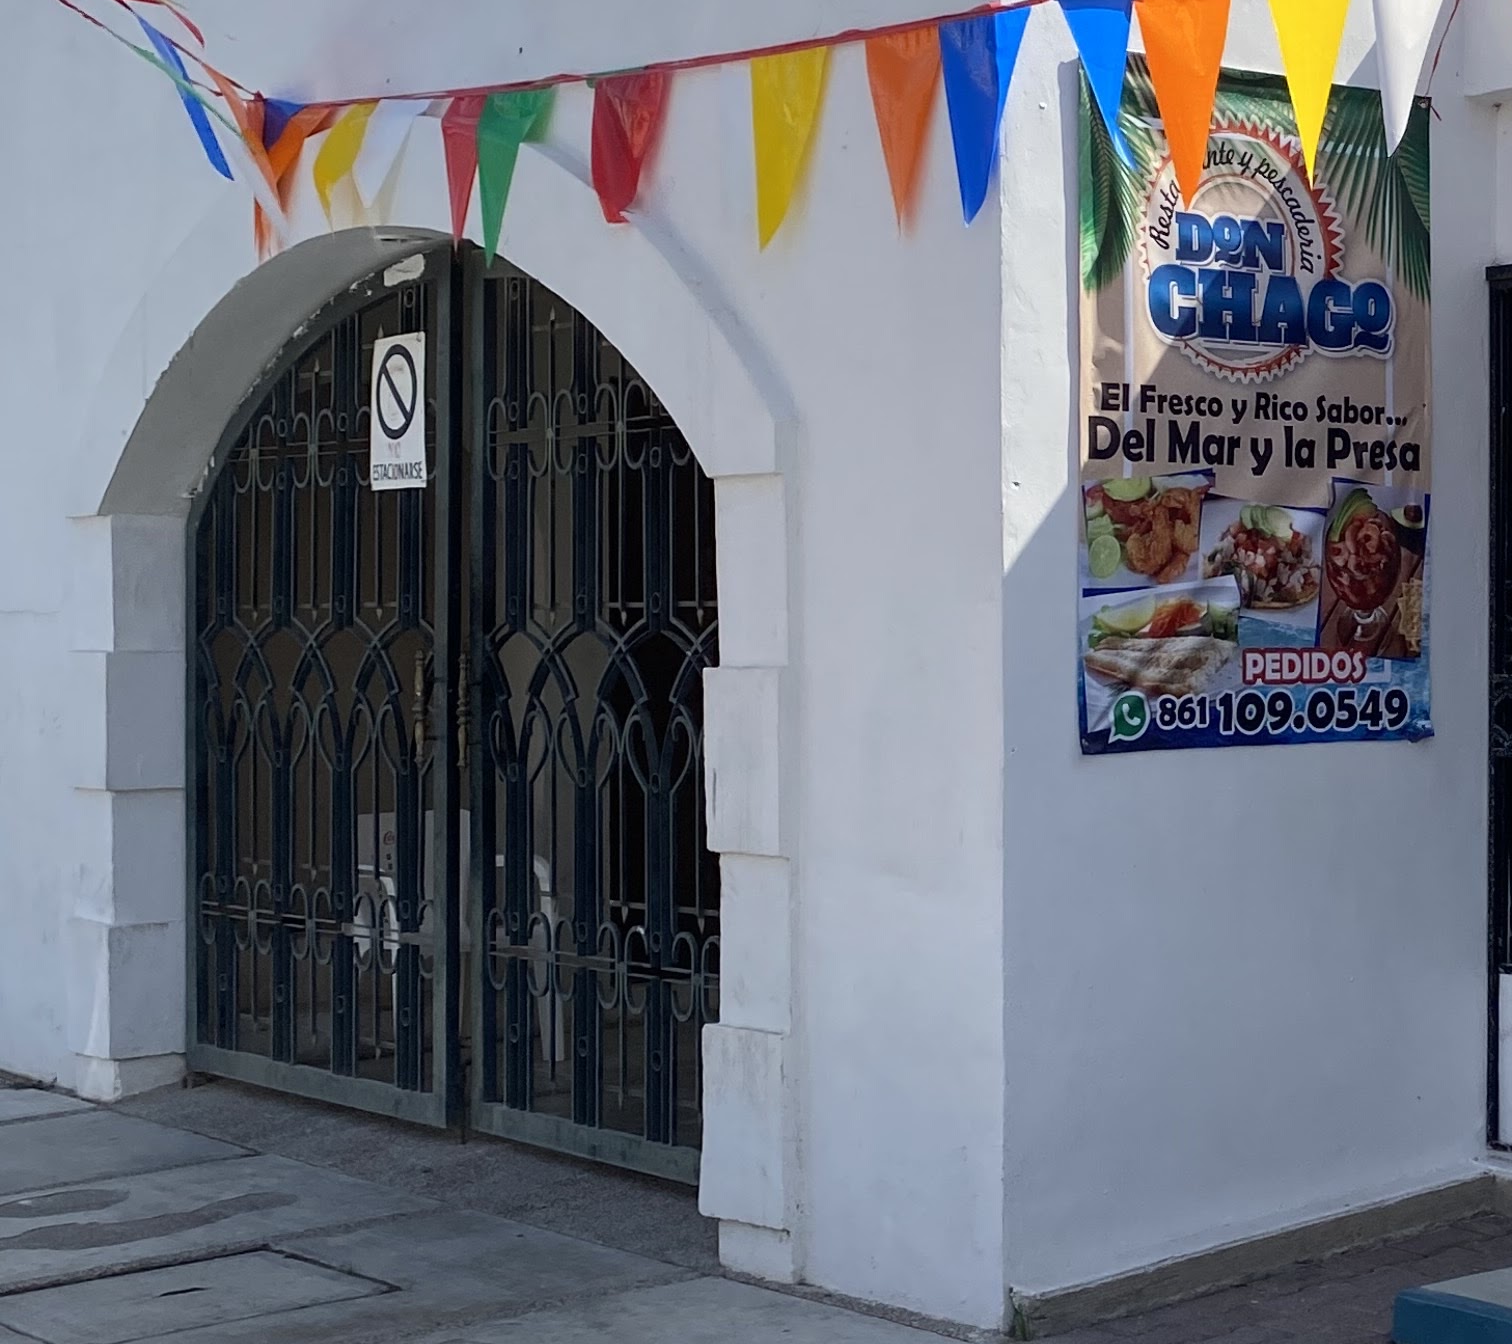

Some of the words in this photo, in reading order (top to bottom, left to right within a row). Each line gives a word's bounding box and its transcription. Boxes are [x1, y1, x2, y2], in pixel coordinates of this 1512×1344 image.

[1149, 140, 1236, 250] Restante
[1237, 151, 1252, 175] y
[1175, 211, 1286, 272] DON
[1149, 263, 1391, 350] CHAGO
[1101, 382, 1130, 411] El
[1140, 385, 1224, 417] Fresco
[1231, 399, 1248, 425] y
[1255, 392, 1309, 421] Rico
[1316, 394, 1408, 427] Sabor...
[1088, 416, 1156, 463] Del
[1168, 420, 1242, 466] Mar
[1251, 437, 1273, 476] y
[1285, 425, 1316, 469] la
[1327, 427, 1421, 472] Presa
[1245, 651, 1366, 682] PEDIDOS
[1160, 696, 1208, 729] 861
[1220, 690, 1409, 735] 109.0549
